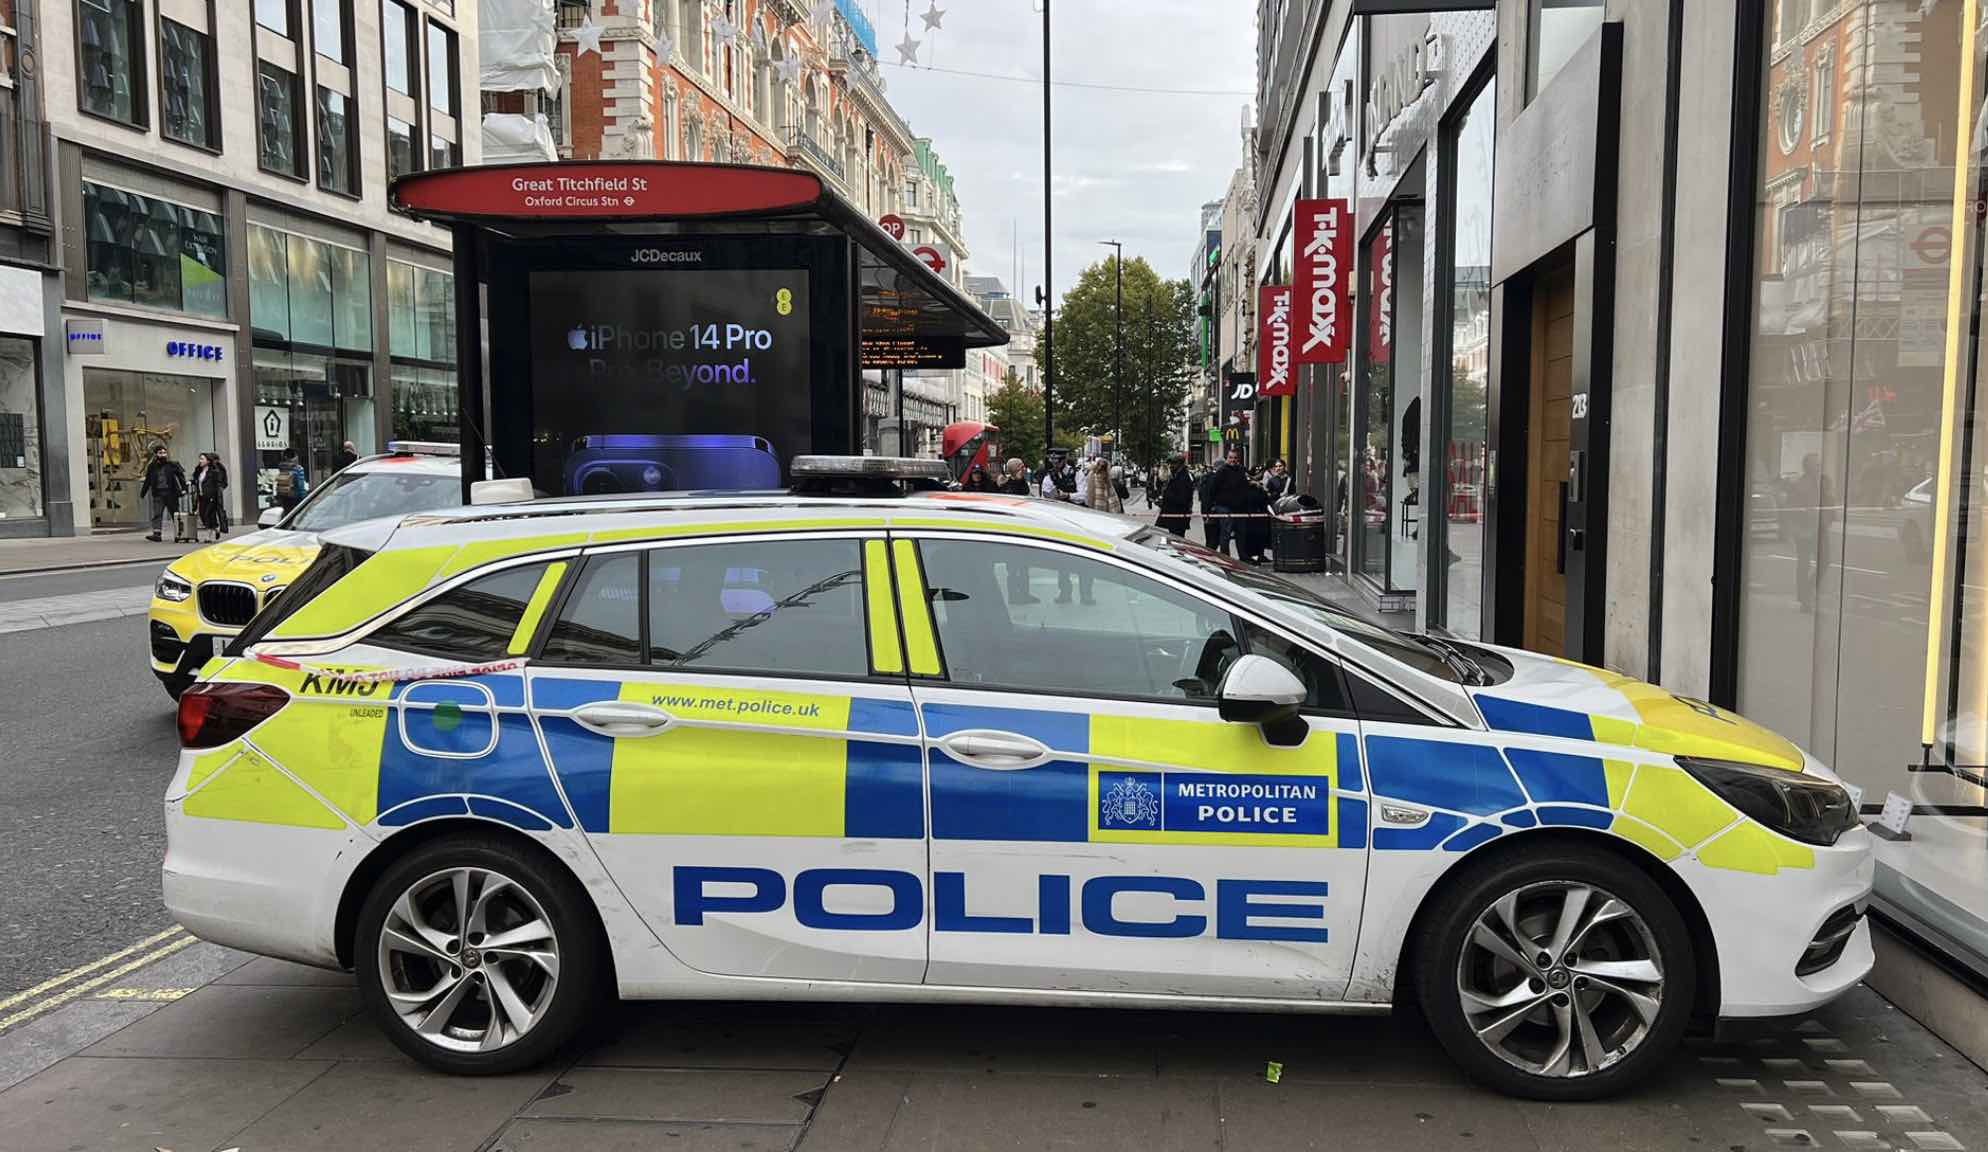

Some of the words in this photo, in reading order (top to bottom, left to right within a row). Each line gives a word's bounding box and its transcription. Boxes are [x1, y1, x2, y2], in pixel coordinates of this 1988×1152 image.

[512, 178, 554, 191] Great
[557, 178, 628, 191] Titchfield
[632, 178, 648, 191] St
[525, 196, 562, 206] Oxford
[565, 196, 598, 206] Circus
[601, 196, 619, 206] Stn
[631, 249, 702, 262] JCDecaux
[591, 325, 685, 350] iPhone
[689, 324, 720, 350] 14
[726, 324, 772, 350] Pro
[166, 341, 223, 362] OFFICE
[1231, 383, 1253, 399] JD
[1572, 393, 1588, 419] 213
[350, 708, 384, 718] UNLEADED
[652, 694, 820, 717] www.met.police.uk
[1178, 783, 1317, 799] METROPOLITAN
[1198, 805, 1297, 823] POLICE
[673, 865, 1330, 944] POLICE
